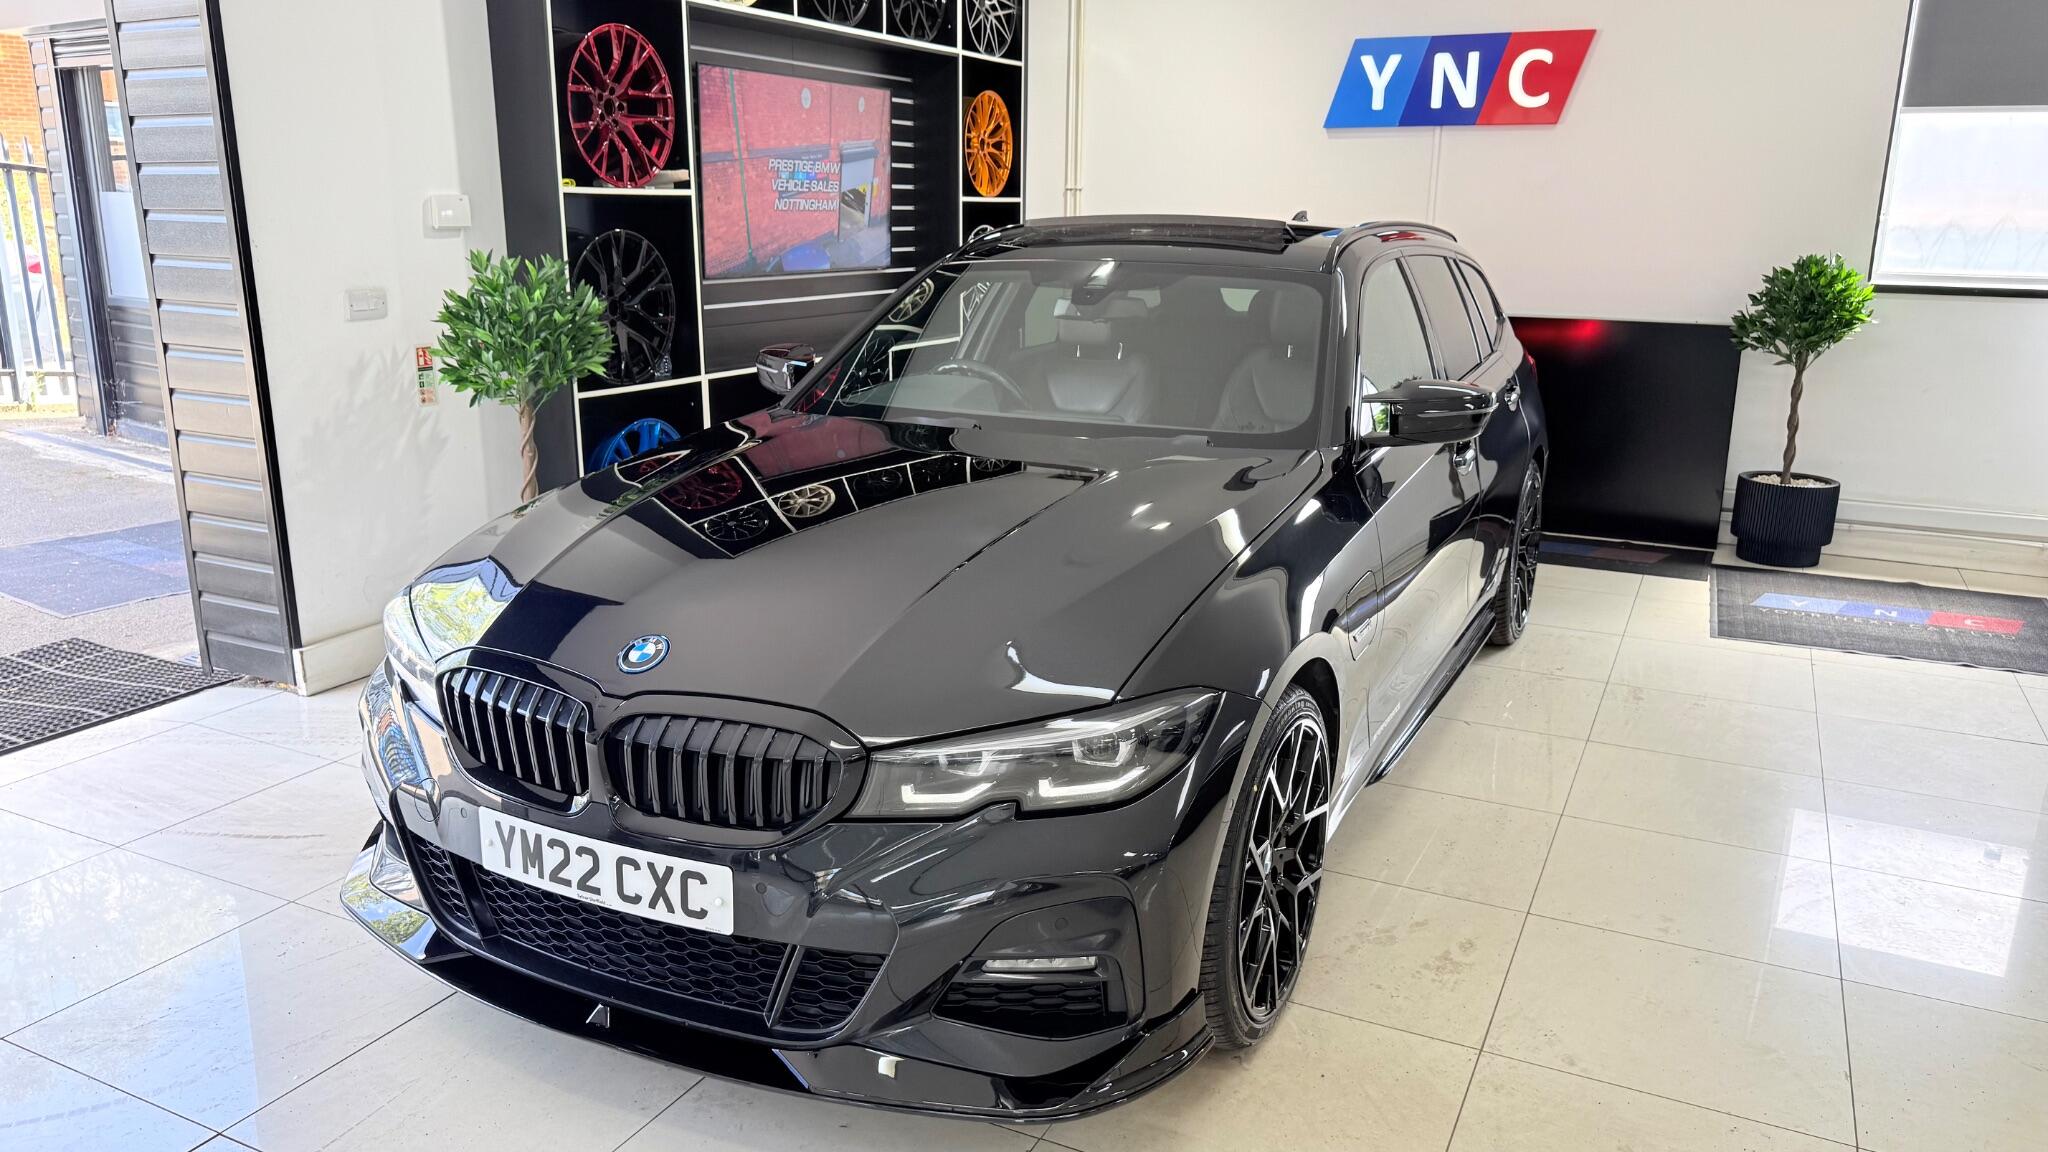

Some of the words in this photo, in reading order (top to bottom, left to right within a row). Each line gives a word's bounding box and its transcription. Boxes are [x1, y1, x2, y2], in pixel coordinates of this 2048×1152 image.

[1360, 48, 1553, 111] YNC
[768, 158, 813, 173] PRESTIGE
[815, 160, 841, 174] BMW
[772, 179, 808, 192] VEHICLE
[810, 180, 839, 193] SALES
[495, 820, 601, 896] YM22
[615, 855, 709, 920] CXC
